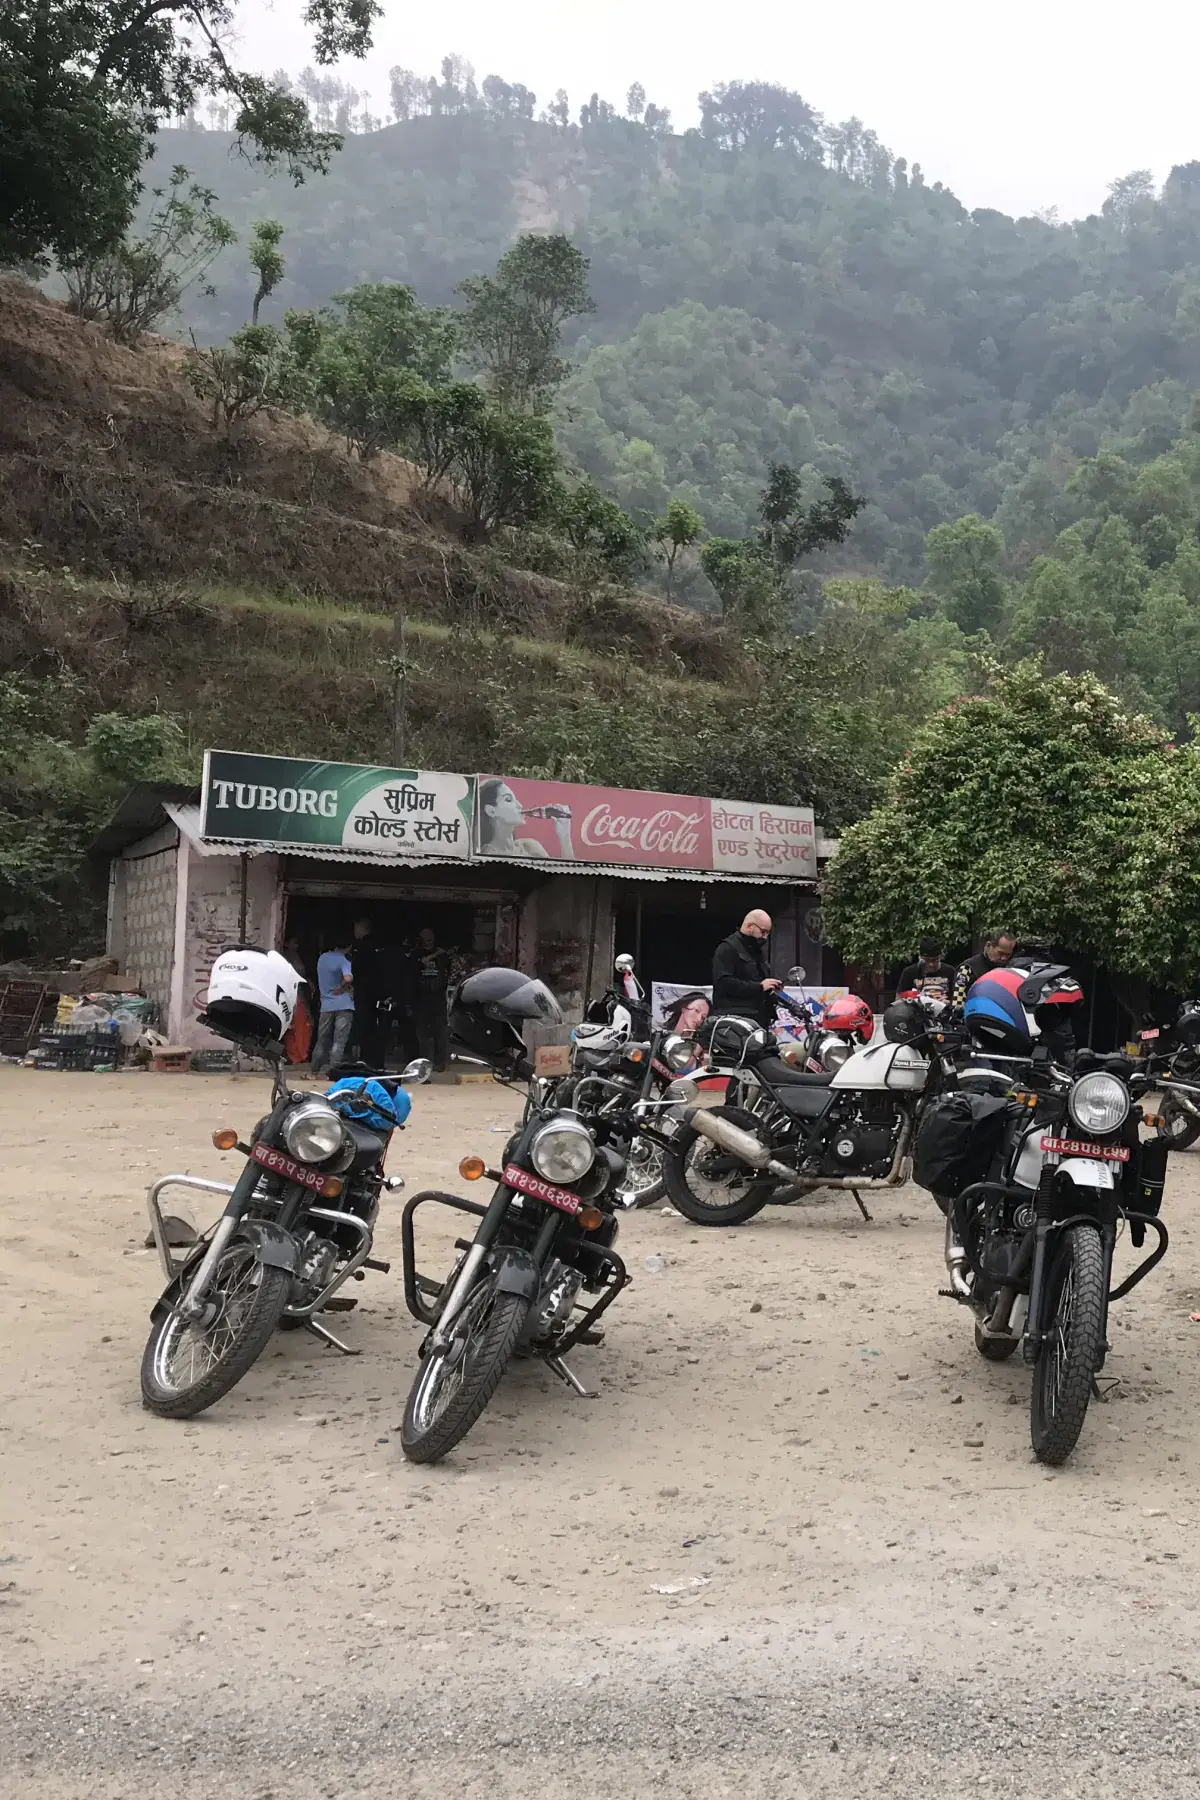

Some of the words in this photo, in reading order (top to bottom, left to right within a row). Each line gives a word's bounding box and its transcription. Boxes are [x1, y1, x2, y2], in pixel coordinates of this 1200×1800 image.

[212, 779, 338, 818] TUBORG
[384, 784, 436, 814] सुप्रिम
[354, 810, 408, 838] कोल्ड
[413, 816, 461, 843] स्टोर्स
[581, 804, 704, 855] Coca-Cola
[712, 807, 754, 831] होटल
[717, 839, 750, 856] एण्ड
